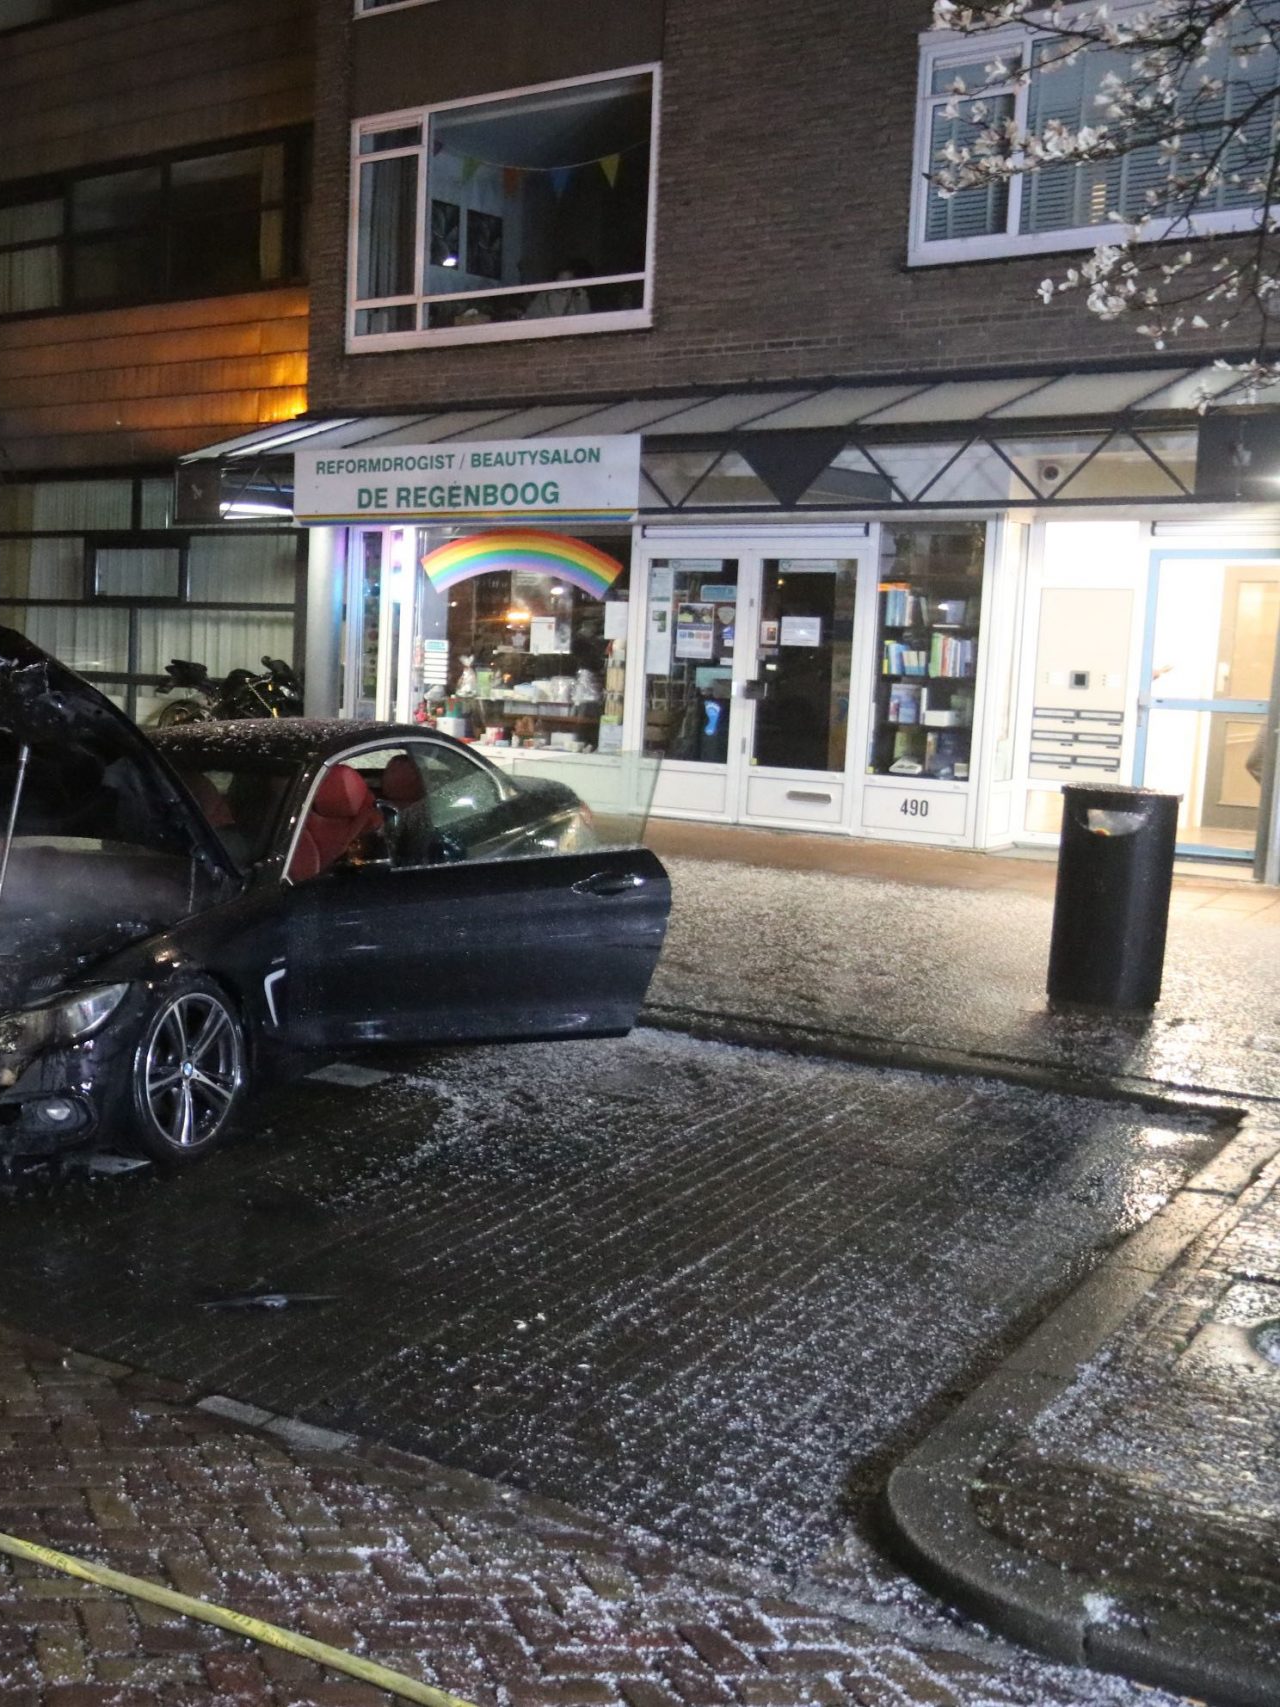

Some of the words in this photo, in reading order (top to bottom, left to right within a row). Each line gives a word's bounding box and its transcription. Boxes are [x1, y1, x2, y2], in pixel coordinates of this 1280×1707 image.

[315, 454, 455, 475] REFORMDROGIST
[459, 453, 466, 470] /
[471, 447, 601, 468] BEAUTYSALON
[357, 488, 388, 509] DE
[396, 481, 560, 508] REGENBOOG
[900, 798, 929, 817] 490
